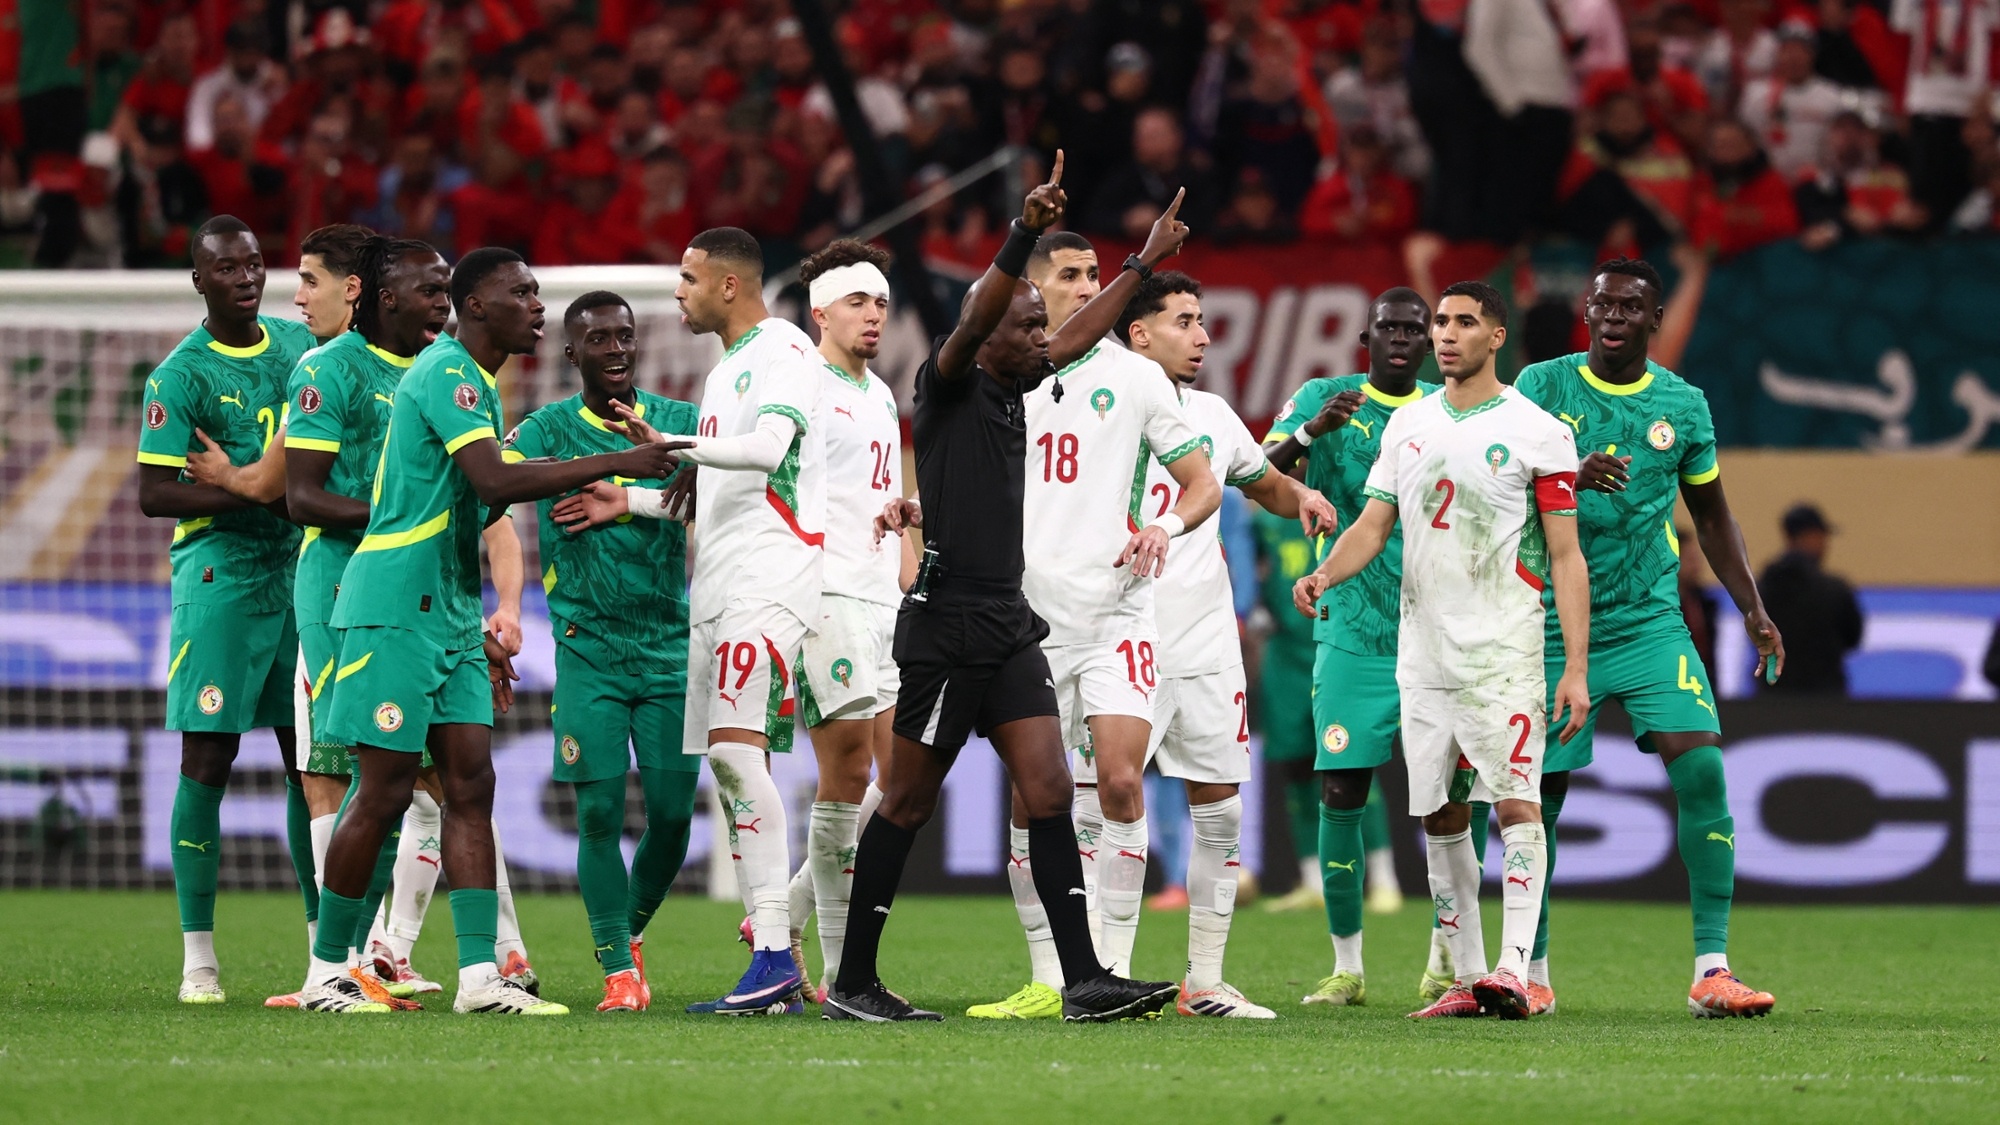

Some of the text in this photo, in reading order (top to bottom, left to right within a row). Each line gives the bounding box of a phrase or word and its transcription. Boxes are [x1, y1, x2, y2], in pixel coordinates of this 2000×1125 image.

[870, 440, 892, 492] 24
[1036, 431, 1079, 484] 18
[1431, 478, 1456, 530] 2
[715, 641, 757, 690] 19
[1115, 639, 1156, 688] 18
[1677, 654, 1703, 696] 4
[1233, 691, 1249, 743] 2
[1509, 713, 1533, 764] 2
